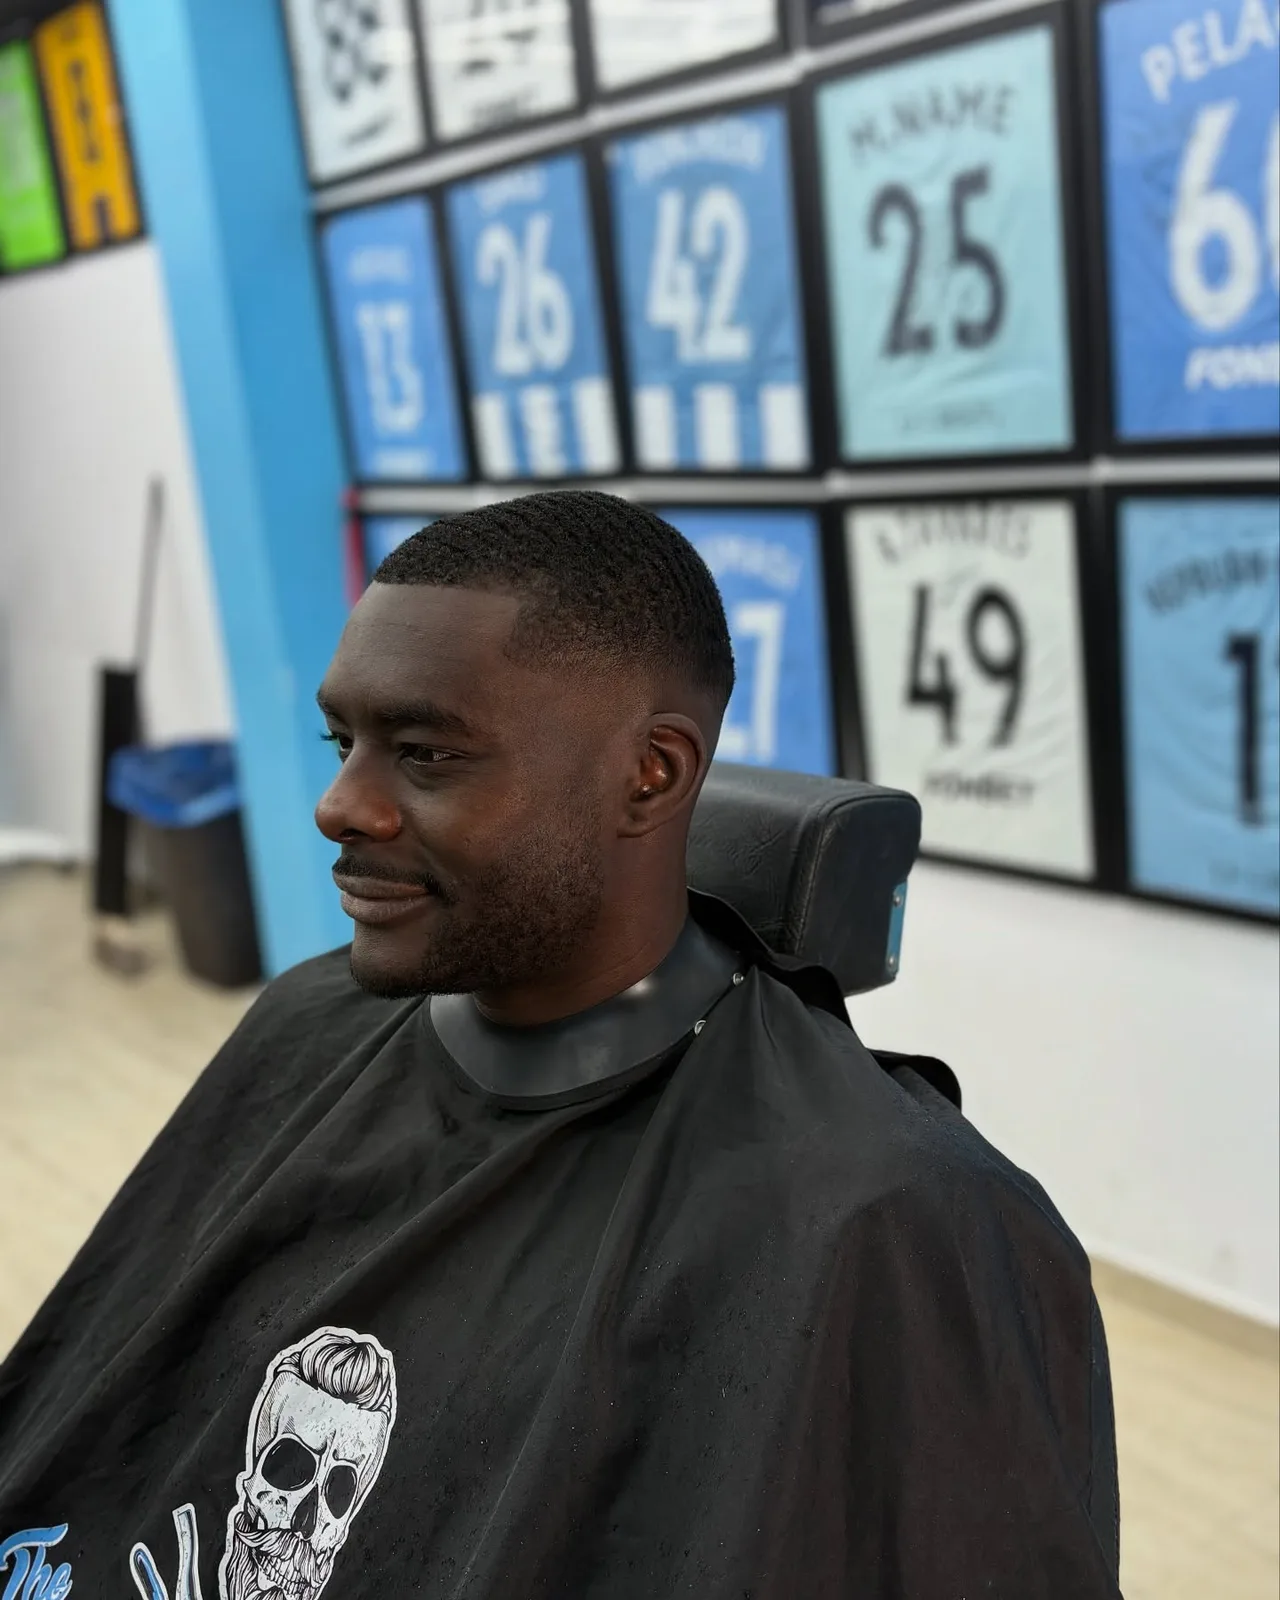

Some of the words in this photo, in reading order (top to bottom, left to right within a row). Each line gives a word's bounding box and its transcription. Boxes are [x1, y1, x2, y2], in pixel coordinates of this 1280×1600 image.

[1140, 0, 1280, 104] PELA
[475, 213, 574, 376] 26
[646, 185, 758, 363] 42
[867, 165, 1008, 359] 25
[1168, 100, 1280, 333] 6
[906, 580, 1028, 748] 49
[1222, 631, 1280, 828] 1
[0, 1523, 73, 1600] The
